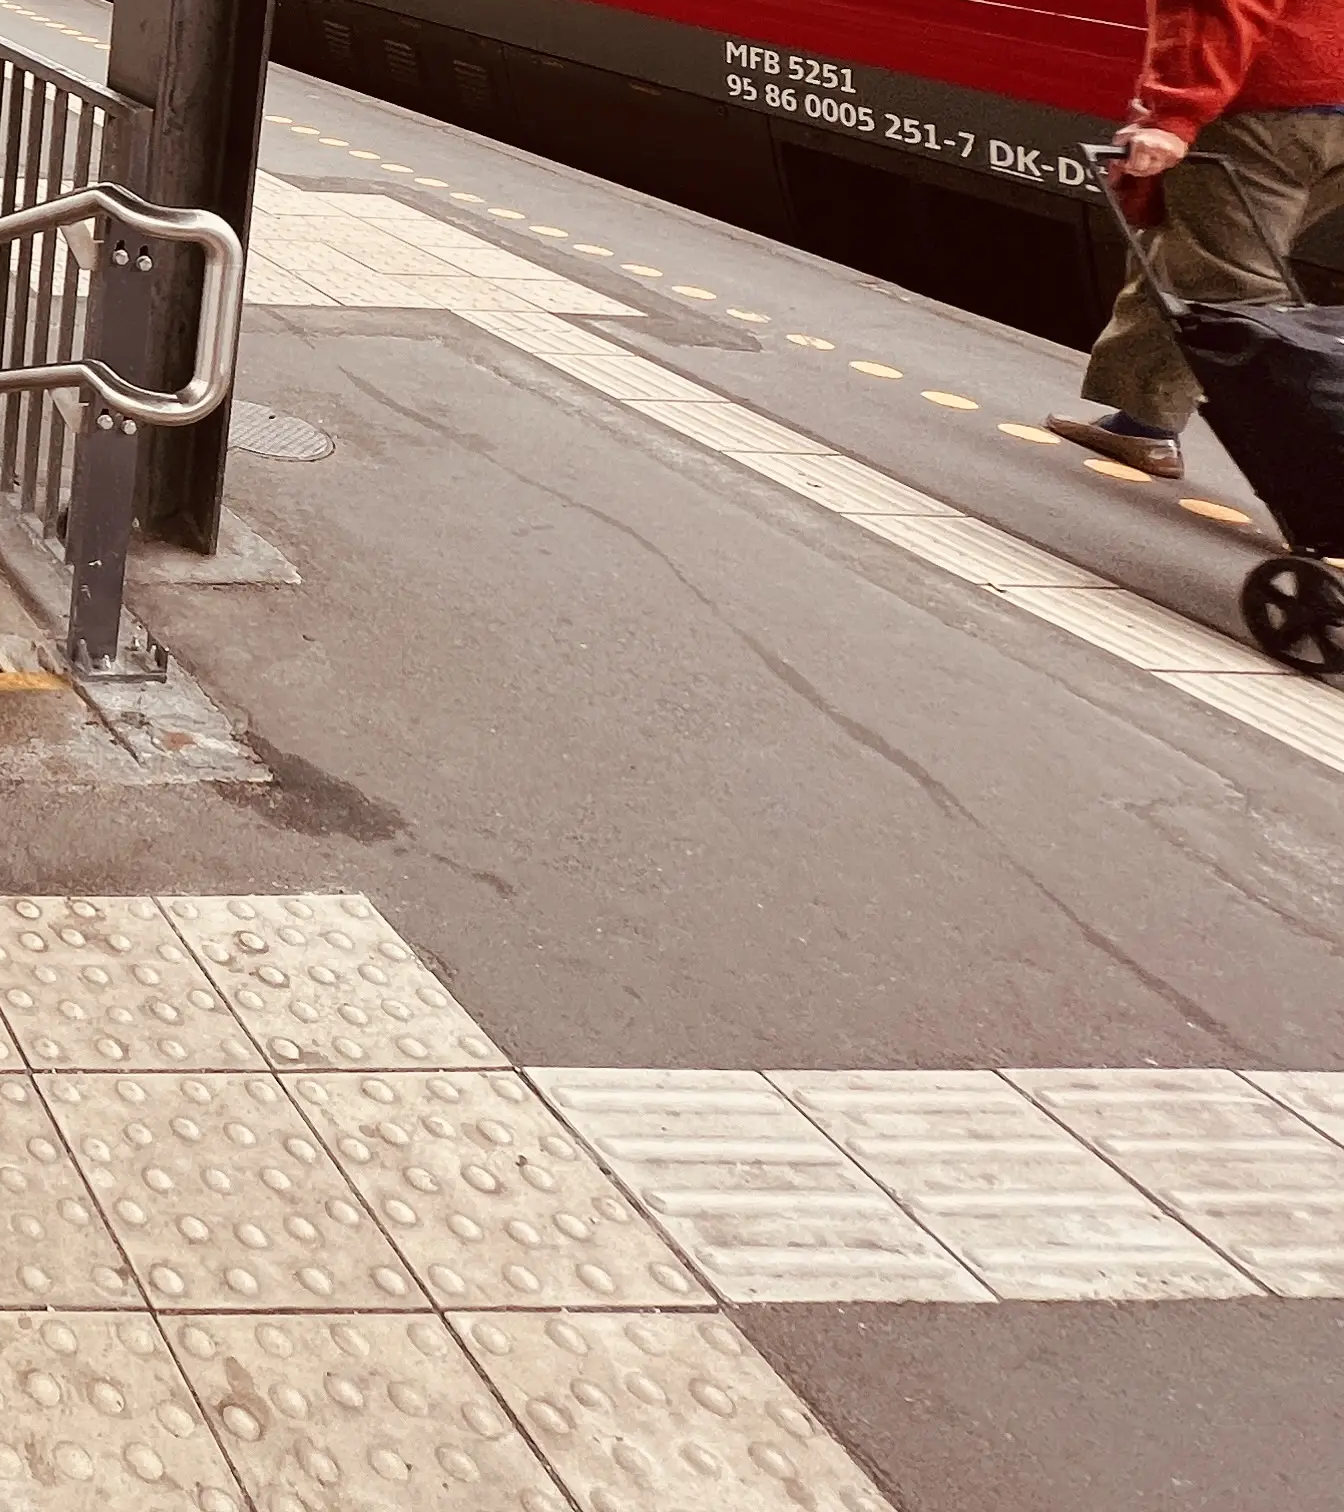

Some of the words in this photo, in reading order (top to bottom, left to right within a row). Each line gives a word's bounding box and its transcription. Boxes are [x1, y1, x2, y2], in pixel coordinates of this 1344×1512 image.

[725, 40, 781, 76] MFB
[788, 55, 857, 94] 5251
[726, 73, 758, 102] 95
[764, 83, 798, 112] 86
[804, 93, 875, 132] 0005
[885, 113, 976, 159] 251-7
